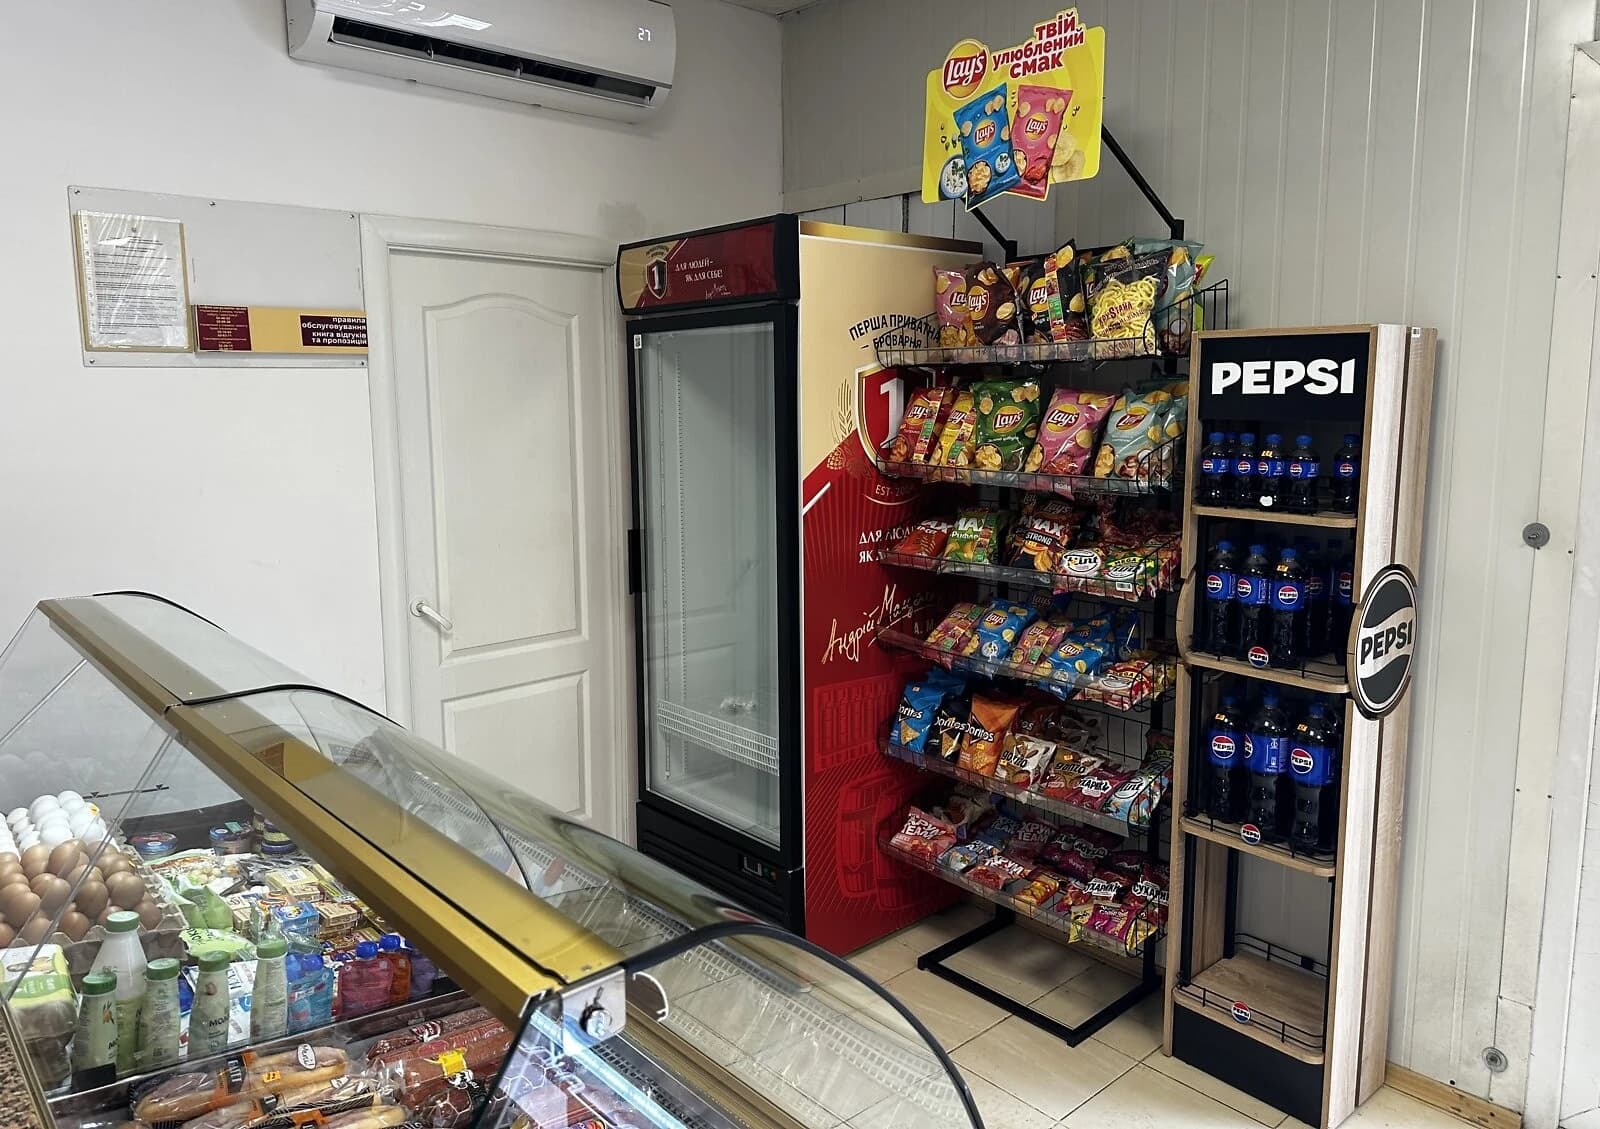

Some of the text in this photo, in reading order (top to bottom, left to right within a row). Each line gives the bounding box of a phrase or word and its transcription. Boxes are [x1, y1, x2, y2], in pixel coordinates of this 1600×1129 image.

[638, 27, 650, 41] 27
[992, 28, 1084, 70] улюблений
[946, 52, 986, 86] Lay's
[1009, 52, 1064, 78] смак
[1026, 116, 1048, 133] Lay's
[976, 123, 996, 144] Lay's
[1030, 287, 1047, 304] Lay
[302, 322, 366, 330] обслуговування
[849, 315, 888, 341] ПЕРША
[336, 331, 366, 339] відгуків
[873, 334, 921, 349] БРОВАРНЯ
[1211, 358, 1355, 395] PEPSI
[995, 411, 1024, 428] Lay's
[1048, 410, 1078, 426] Lay's
[859, 530, 882, 544] ДЛЯ
[1025, 532, 1052, 545] STRONG
[859, 550, 873, 563] ЯК
[985, 612, 1007, 624] Lay's
[1360, 620, 1413, 665] PEPSI
[1250, 652, 1268, 662] PEPSI
[899, 704, 923, 719] oritos
[1212, 743, 1234, 751] PEPSI
[1291, 756, 1312, 766] PEPSI
[1242, 830, 1260, 838] PEPSI
